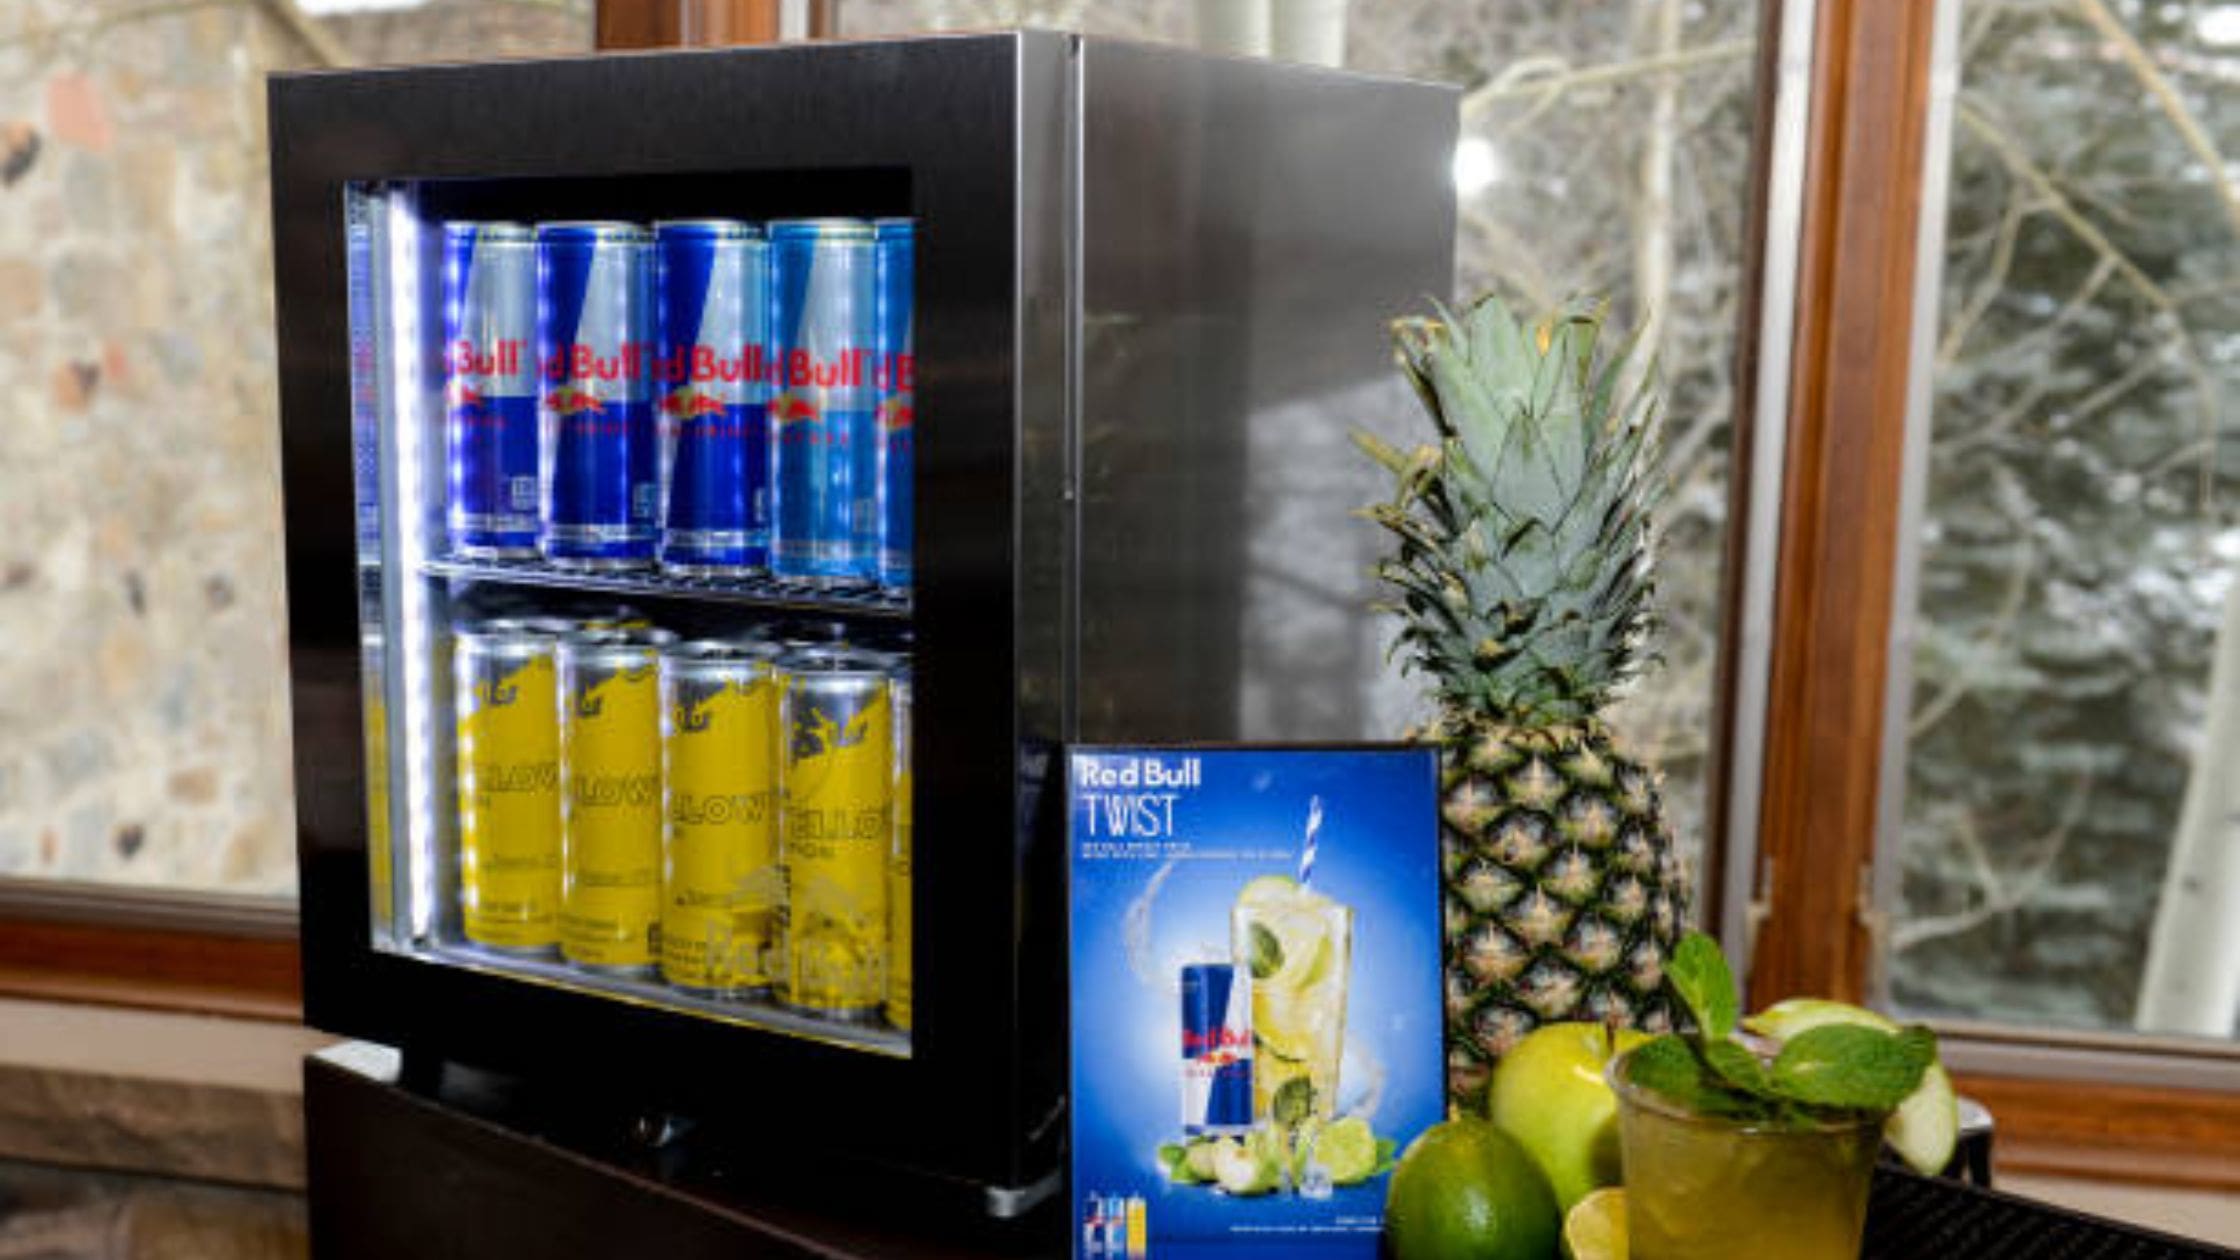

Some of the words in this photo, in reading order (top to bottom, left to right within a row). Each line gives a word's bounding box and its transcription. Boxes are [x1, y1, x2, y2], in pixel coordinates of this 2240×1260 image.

[570, 341, 642, 380] Bull
[691, 344, 761, 383] Bull
[789, 347, 862, 388] Bull
[1081, 759, 1139, 787] Red
[1144, 758, 1200, 787] Bull
[1082, 794, 1178, 836] TWIST
